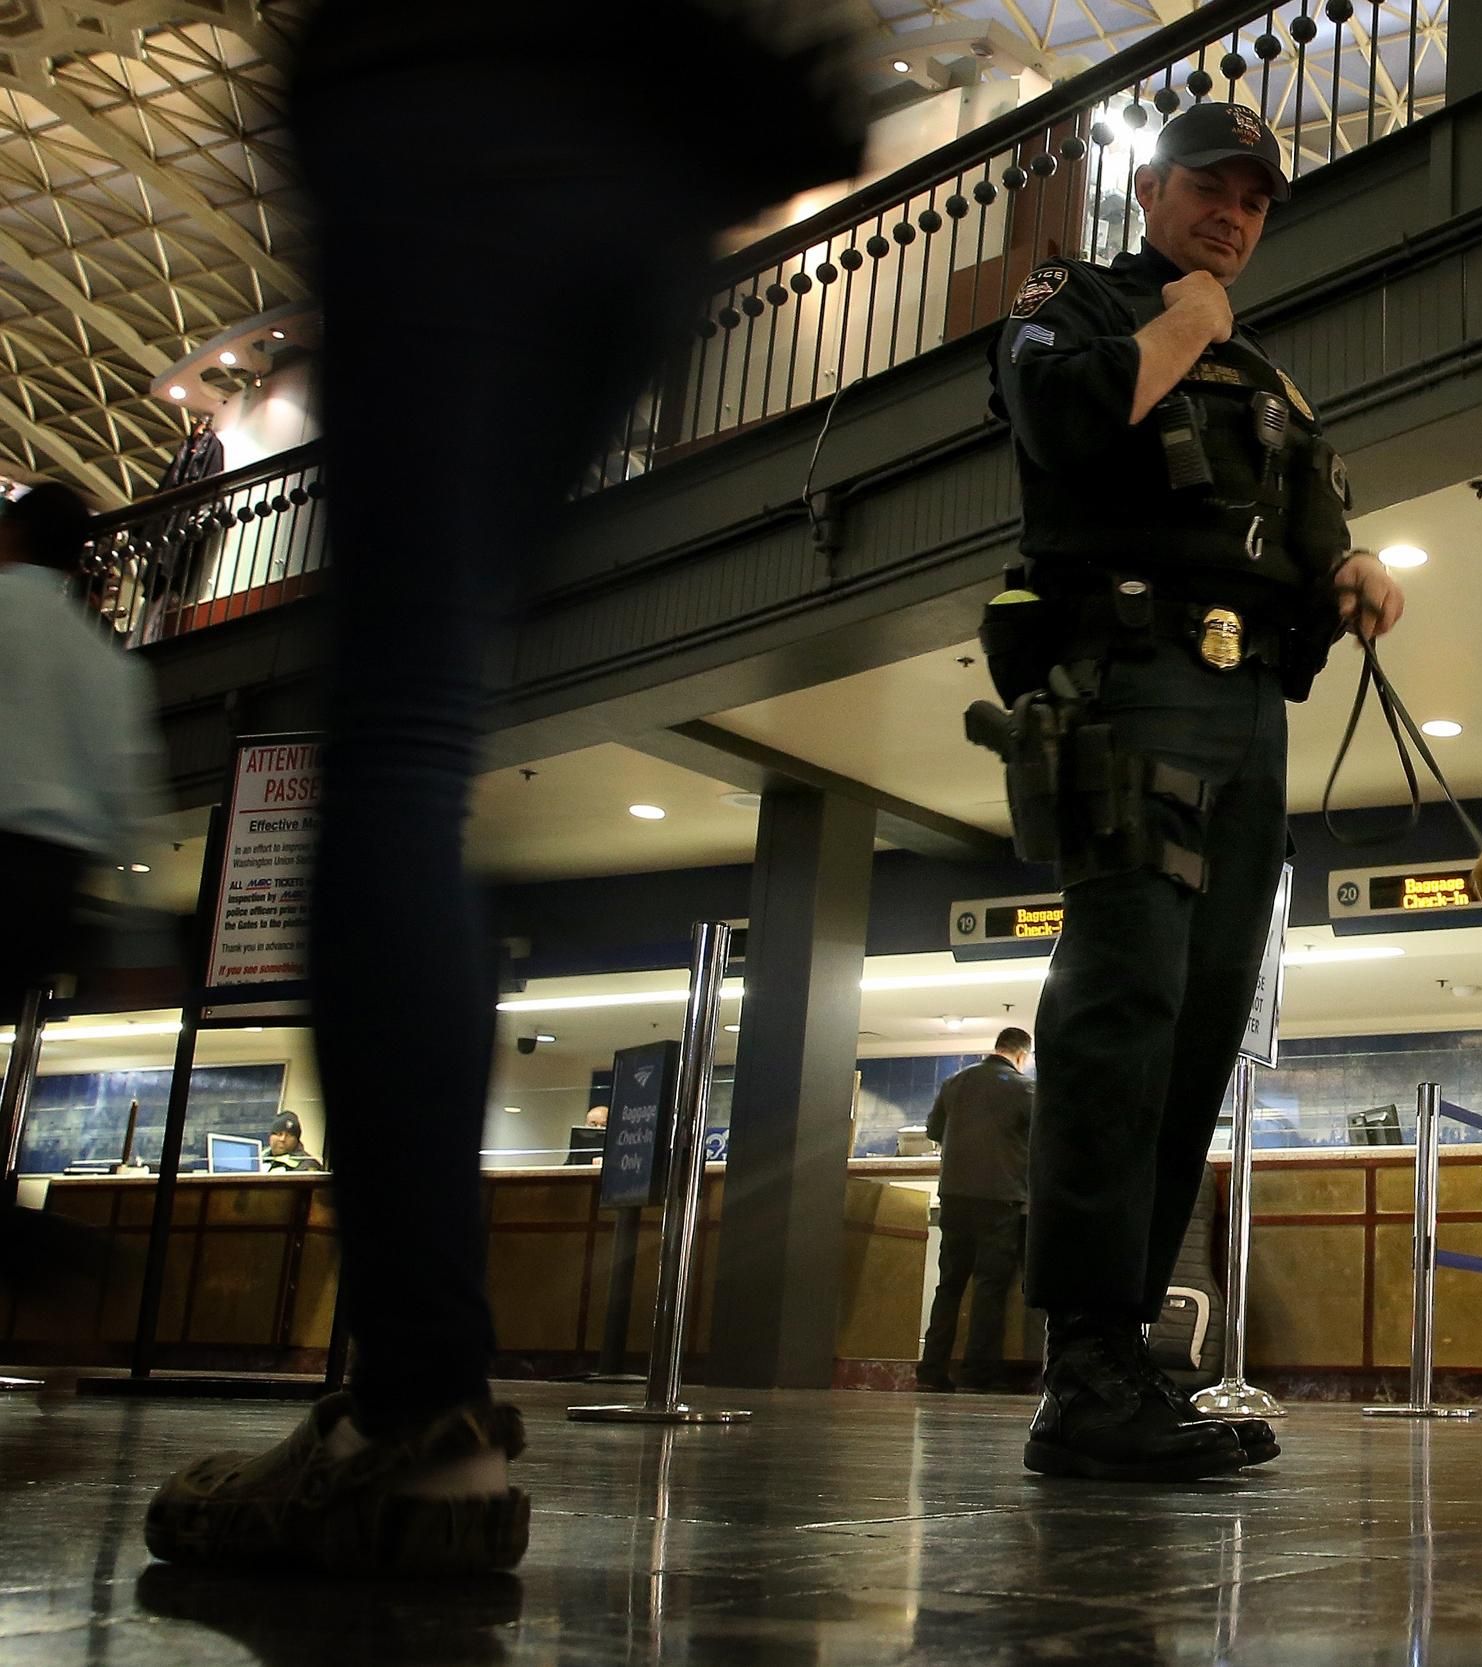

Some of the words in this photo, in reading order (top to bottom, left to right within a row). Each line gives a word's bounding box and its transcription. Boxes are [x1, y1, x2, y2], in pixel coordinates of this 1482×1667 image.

[249, 818, 299, 832] Effective
[233, 857, 273, 868] Washington
[274, 856, 294, 866] Union
[229, 881, 243, 890] ALL
[1404, 878, 1465, 894] Baggage
[1339, 887, 1357, 902] 20
[226, 907, 248, 919] police
[250, 906, 277, 916] officers
[224, 921, 236, 930] the
[237, 920, 258, 930] Gates
[959, 916, 975, 931] 19
[222, 943, 241, 953] Thank
[242, 944, 257, 954] you
[226, 966, 242, 977] you
[242, 965, 258, 975] see
[622, 1104, 657, 1124] Baggage
[620, 1153, 642, 1174] Only
